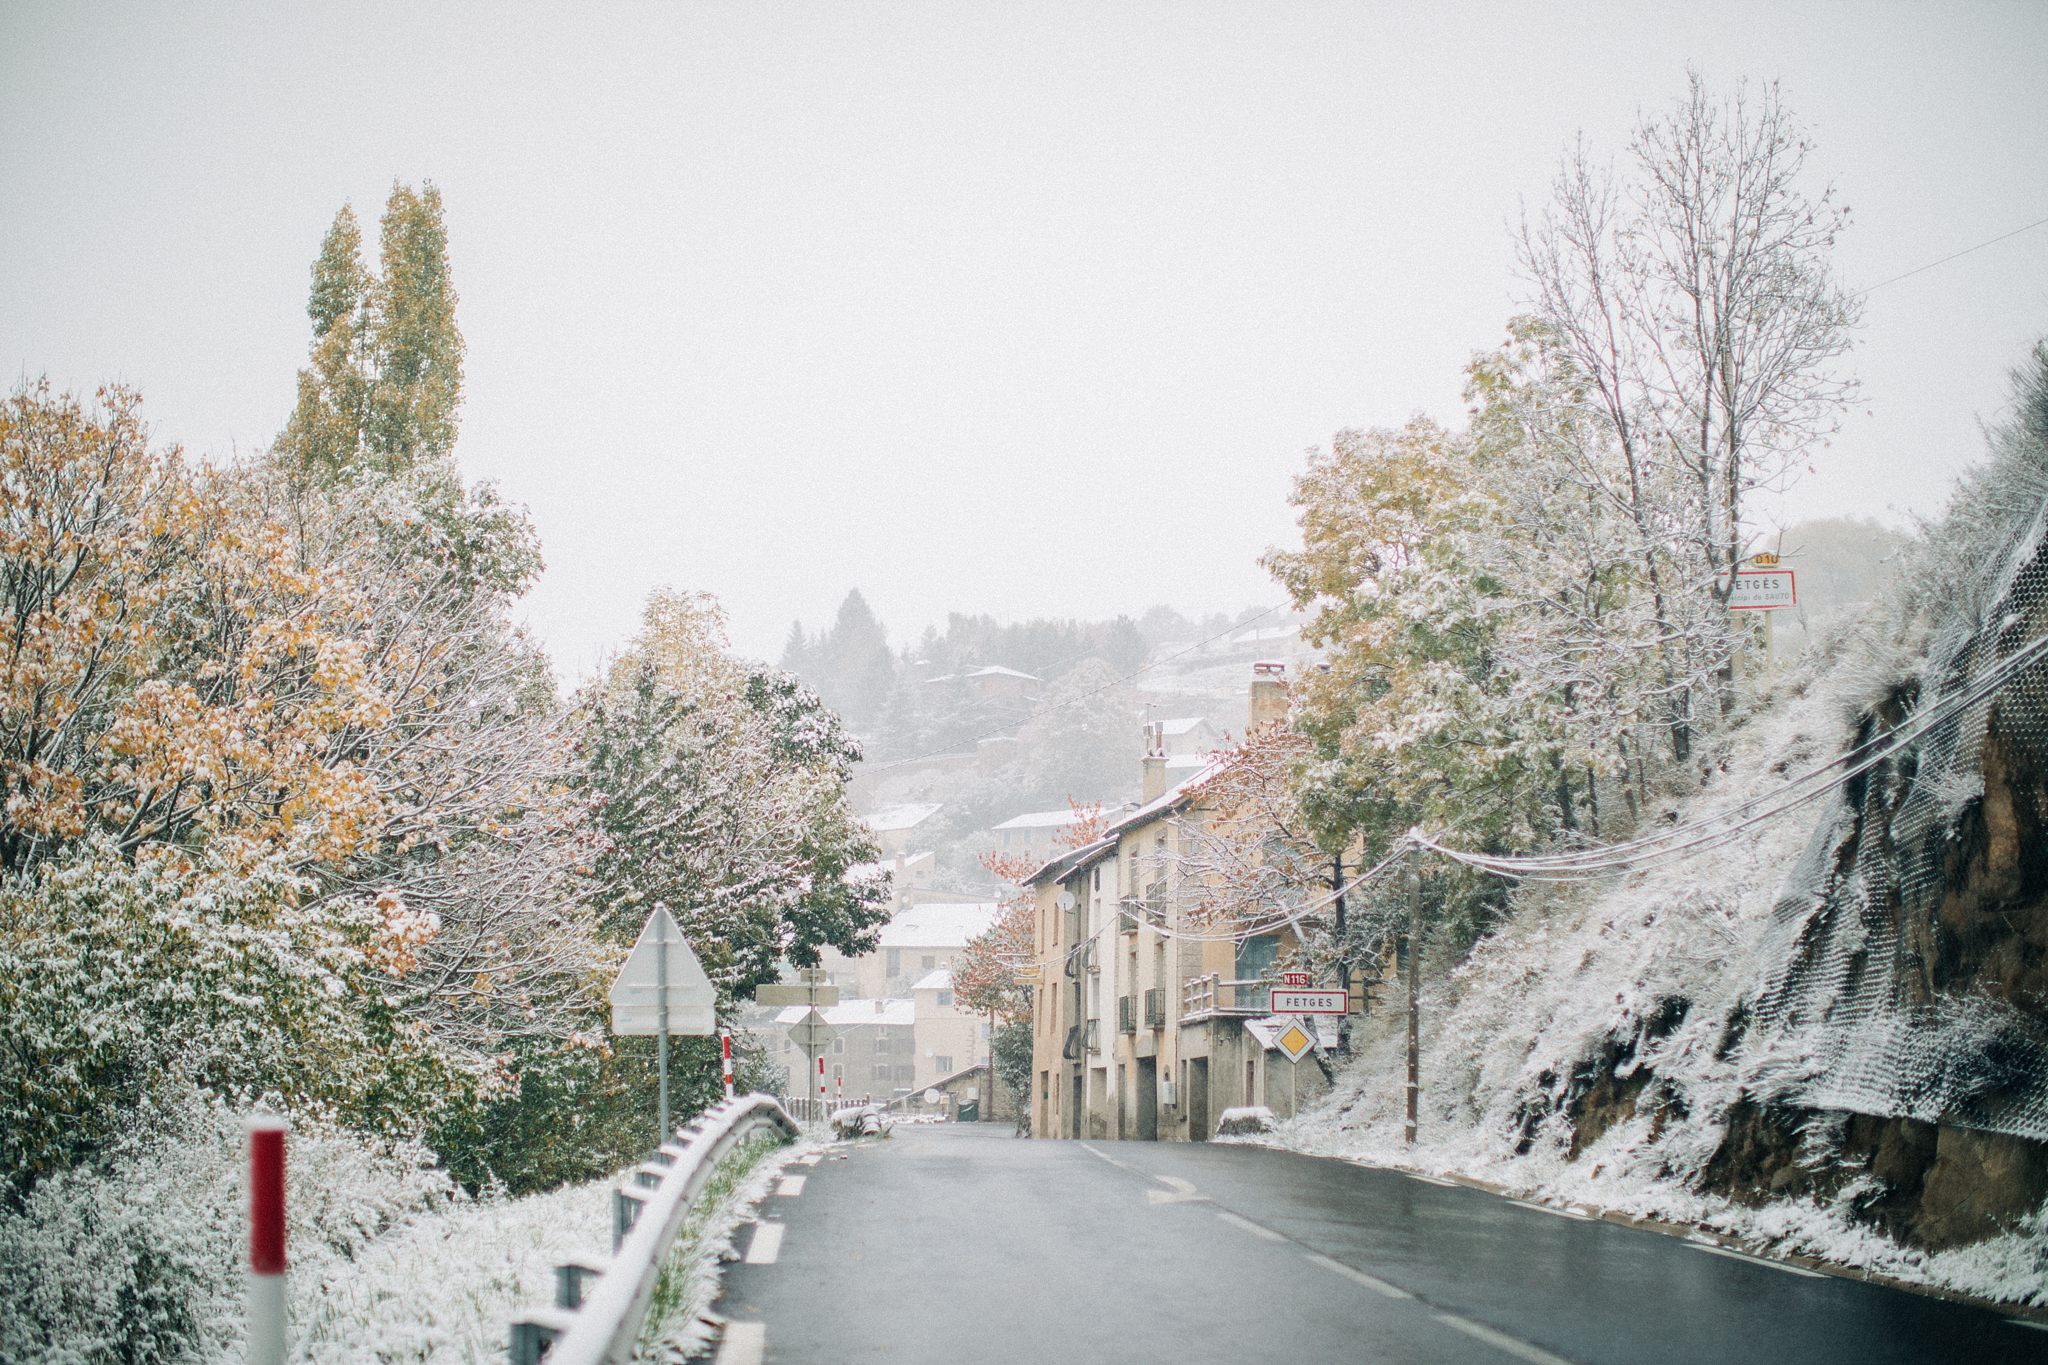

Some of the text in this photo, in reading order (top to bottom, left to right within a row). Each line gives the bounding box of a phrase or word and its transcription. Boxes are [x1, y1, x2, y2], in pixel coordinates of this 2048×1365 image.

[1756, 555, 1778, 564] D10
[1733, 577, 1780, 590] ETGÈS
[1284, 974, 1306, 984] N116
[1286, 997, 1333, 1008] FETGES
